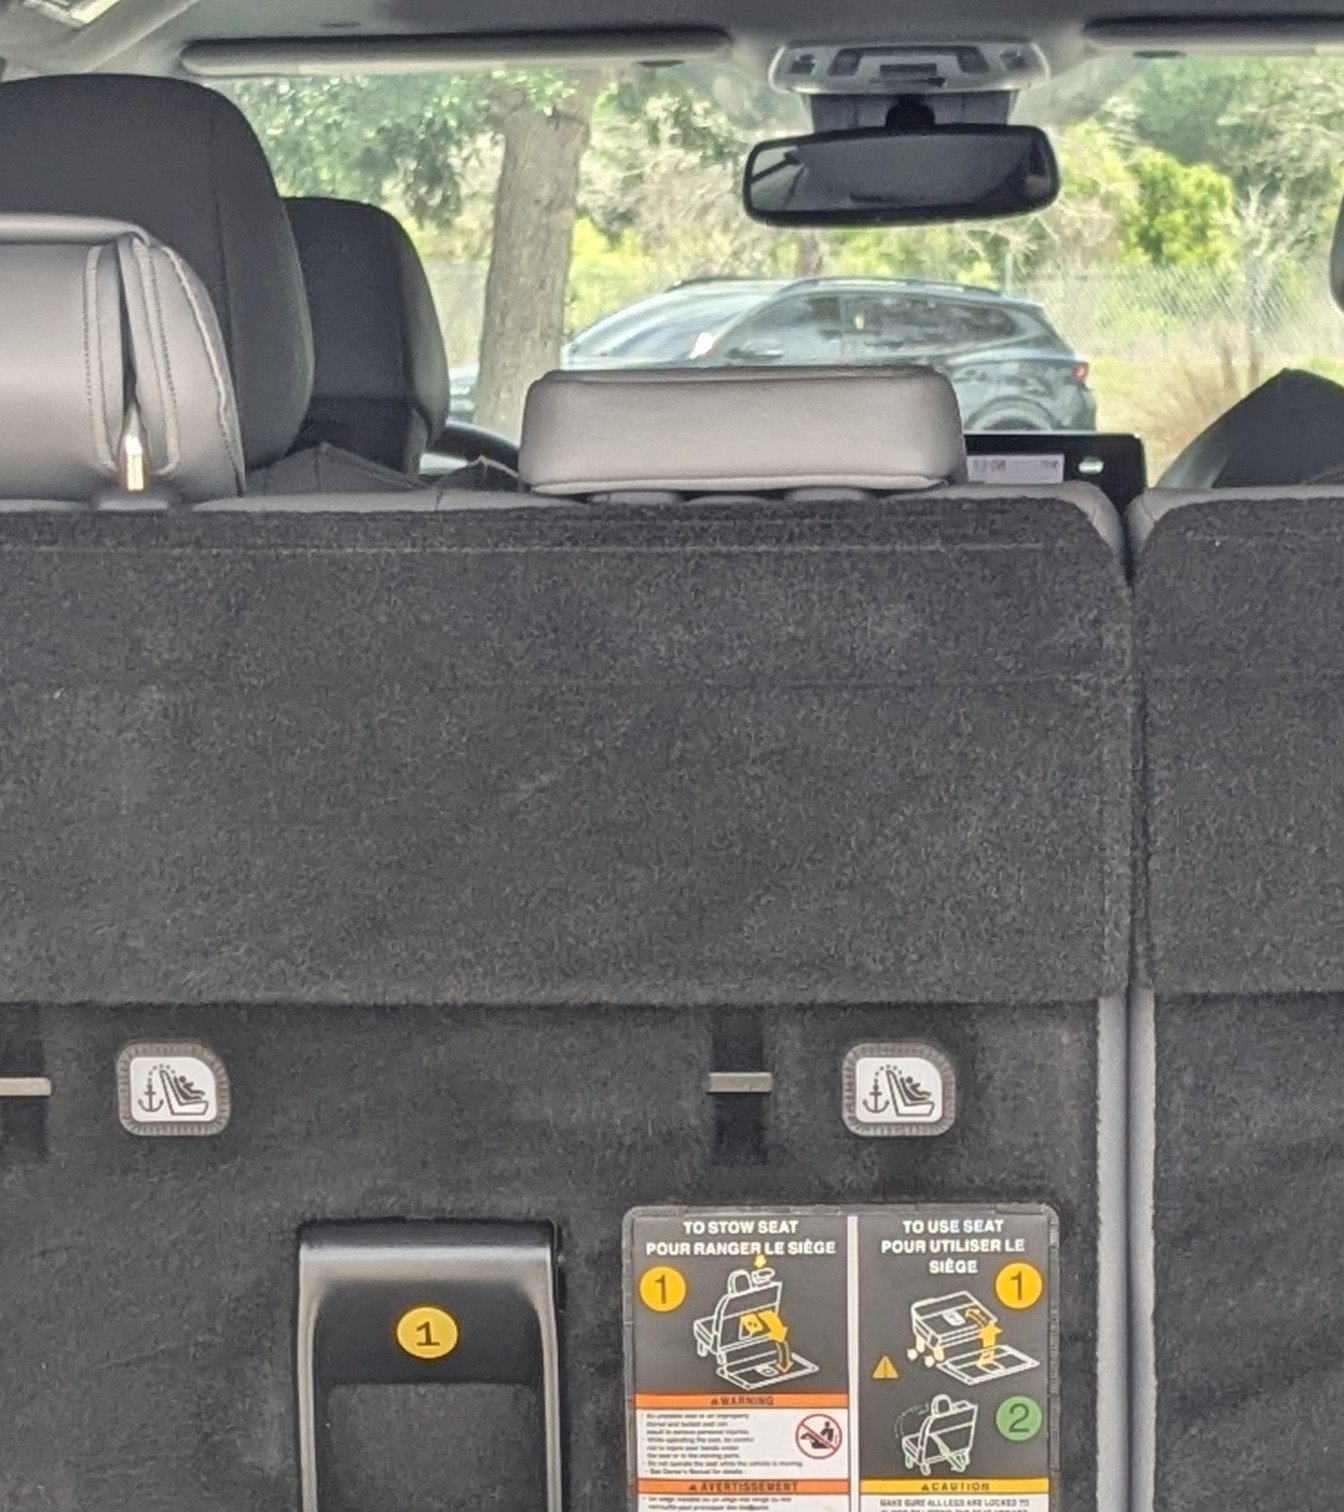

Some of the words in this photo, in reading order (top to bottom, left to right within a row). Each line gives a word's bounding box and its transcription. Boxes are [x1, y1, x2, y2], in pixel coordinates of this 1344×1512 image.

[682, 1220, 705, 1235] TO
[708, 1220, 755, 1235] STOW
[758, 1220, 799, 1234] SEAT
[902, 1220, 925, 1234] TO
[928, 1219, 961, 1234] USE
[963, 1219, 1004, 1233] SEAT
[646, 1242, 691, 1256] POUR
[694, 1242, 762, 1256] RANGER
[764, 1241, 785, 1255] LE
[787, 1238, 837, 1255] SIÈGE
[881, 1240, 926, 1254] POUR
[929, 1239, 1003, 1253] UTILISER
[1004, 1239, 1026, 1252] LE
[928, 1258, 978, 1274] SIÈGE
[654, 1274, 667, 1304] 1
[1010, 1271, 1023, 1301] 1
[415, 1321, 441, 1347] 1
[720, 1395, 774, 1406] WARNING
[1008, 1403, 1029, 1433] 2
[700, 1482, 799, 1491] AVERTISSEMENT
[931, 1482, 990, 1491] CAUTION
